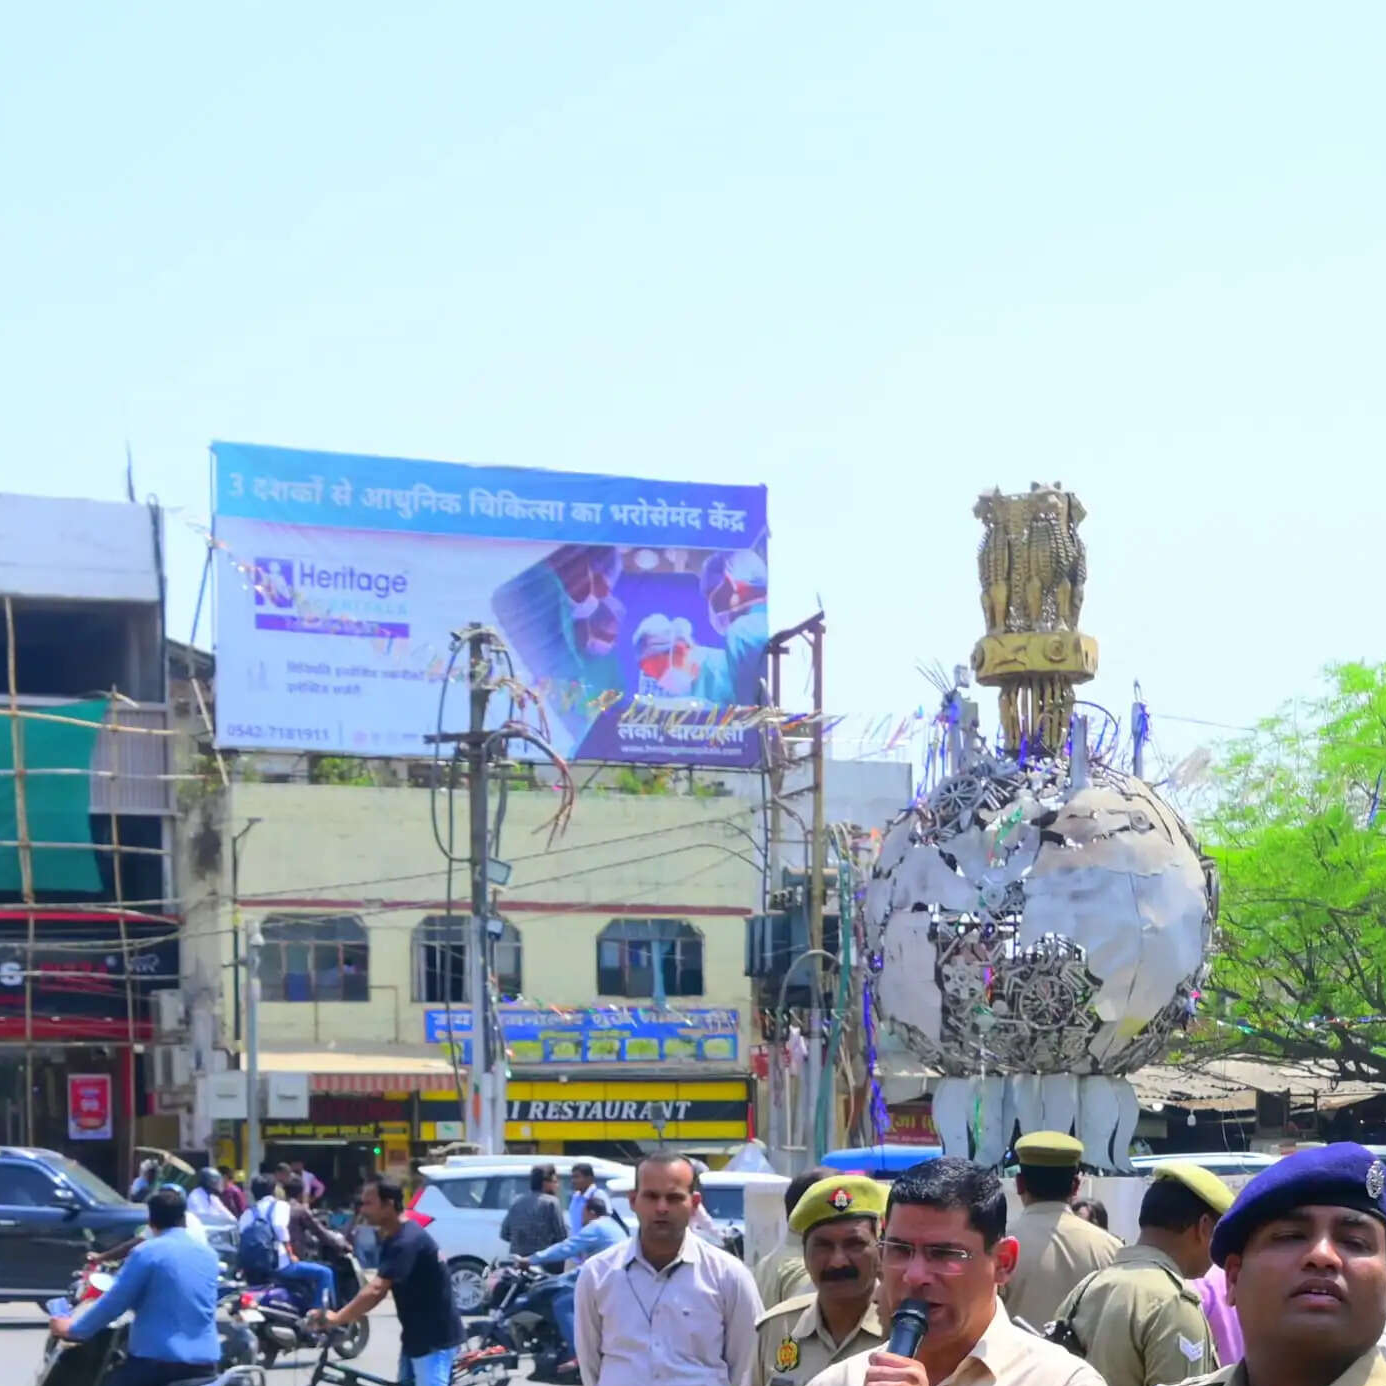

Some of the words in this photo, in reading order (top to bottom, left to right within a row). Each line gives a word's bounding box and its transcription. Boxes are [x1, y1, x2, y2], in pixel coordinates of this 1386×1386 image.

[228, 472, 245, 498] 3
[253, 474, 325, 506] दशकों
[330, 476, 353, 509] से
[362, 481, 463, 521] आधुनिक
[468, 487, 564, 522] चिकित्सा
[570, 501, 604, 525] का
[609, 496, 703, 530] भरोसेमंद
[707, 500, 747, 533] केंद्र
[299, 559, 409, 599] Heritage
[527, 1100, 692, 1121] RESTAURANT
